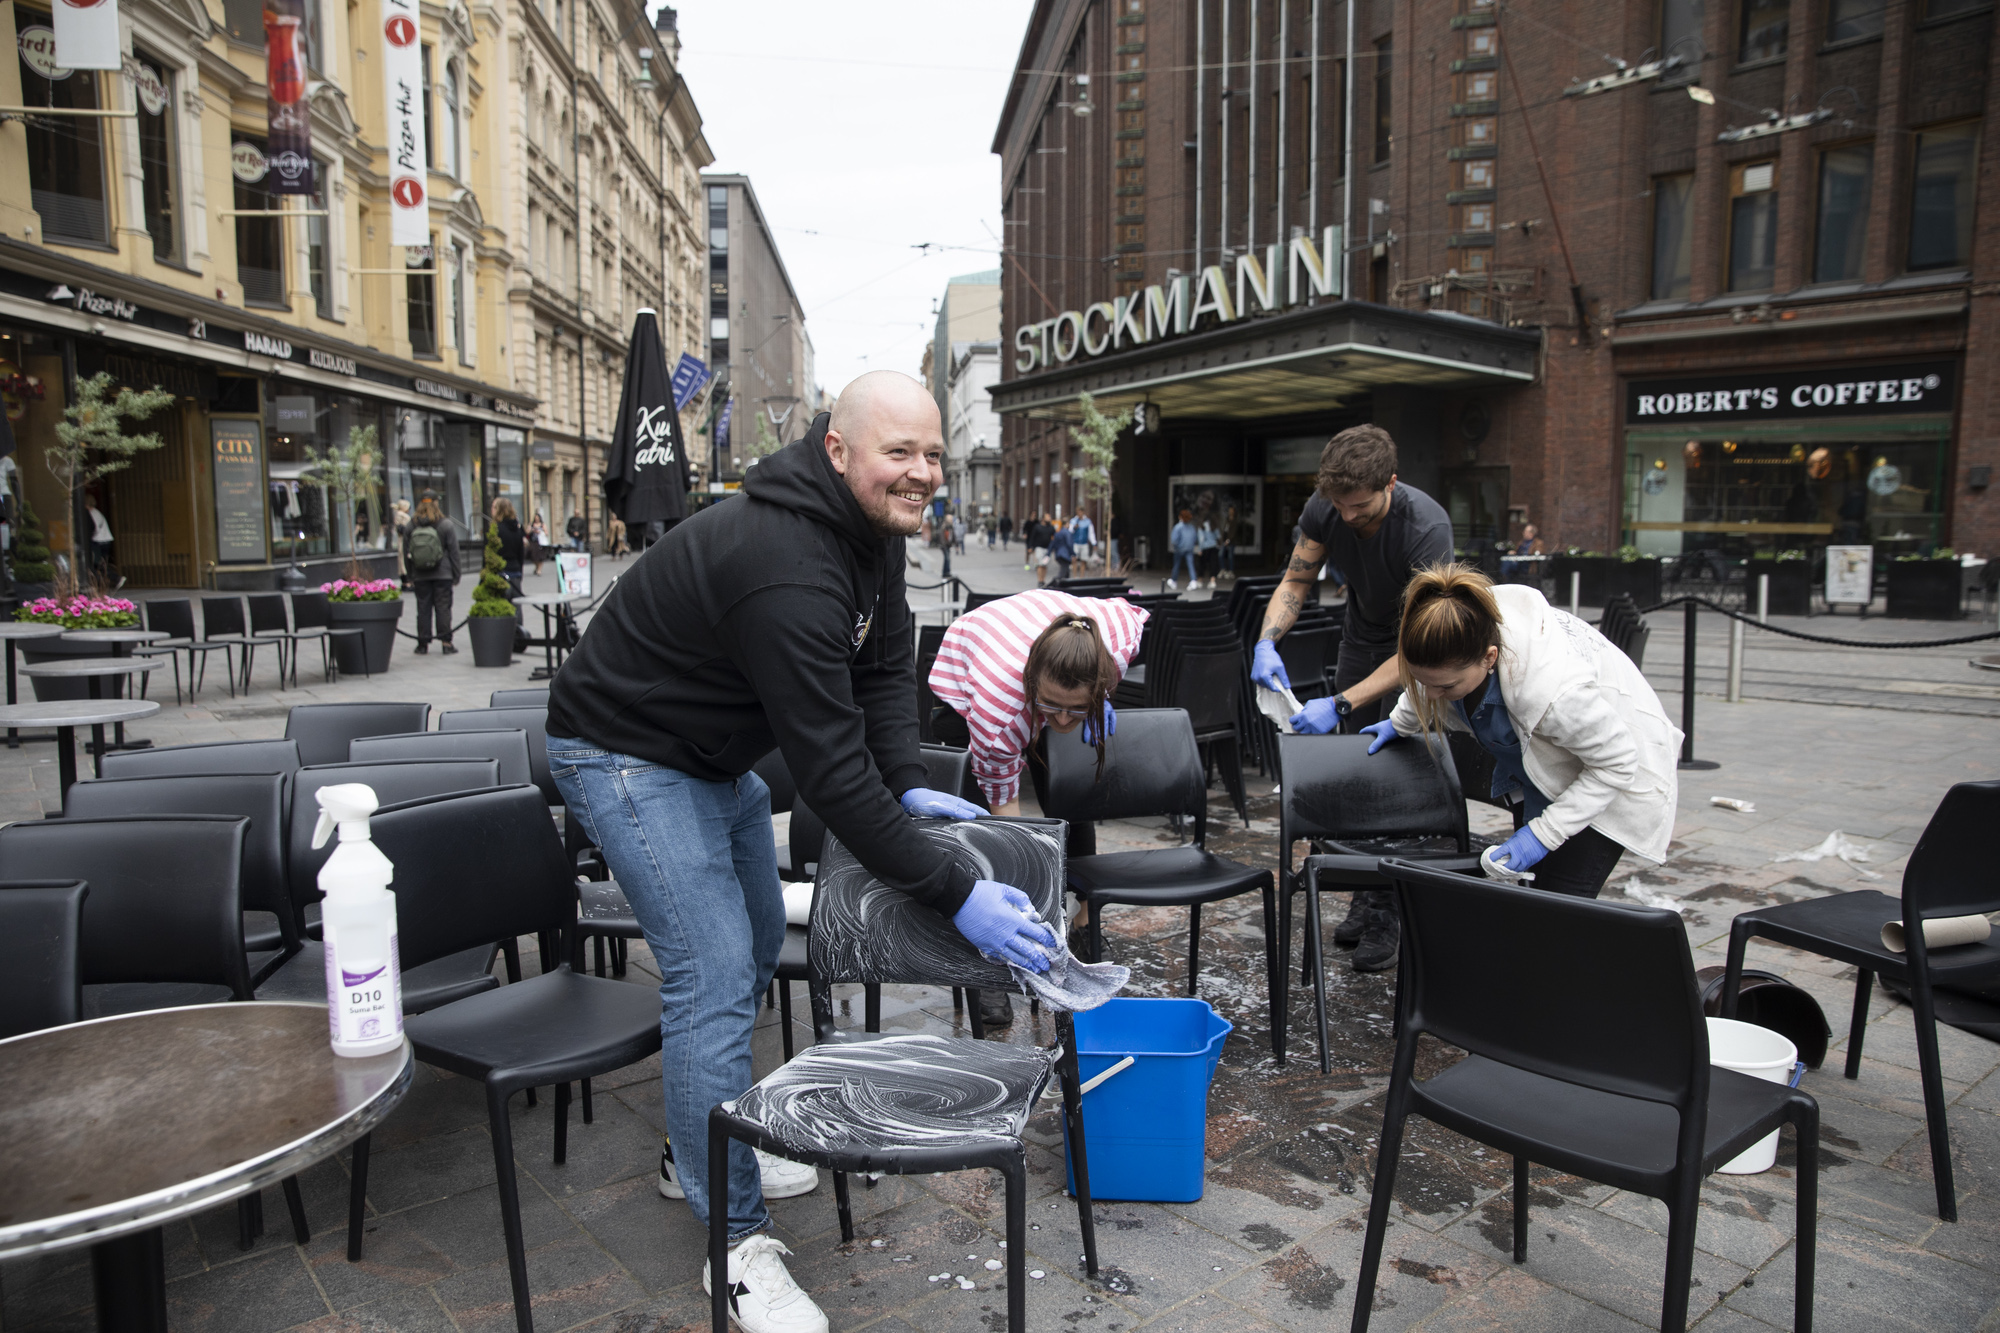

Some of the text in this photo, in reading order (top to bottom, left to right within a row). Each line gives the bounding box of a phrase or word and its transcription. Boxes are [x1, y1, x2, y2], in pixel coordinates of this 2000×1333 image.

[18, 36, 46, 54] ard
[396, 78, 416, 171] Pizza Hut
[77, 287, 139, 321] Pizza Hut
[1015, 225, 1342, 373] STOCKMANN
[190, 317, 207, 339] 21
[244, 330, 292, 359] HARALD
[1637, 387, 1779, 415] ROBERT'S
[216, 439, 254, 454] CITY
[352, 989, 382, 1004] D10
[349, 1006, 371, 1014] Suma
